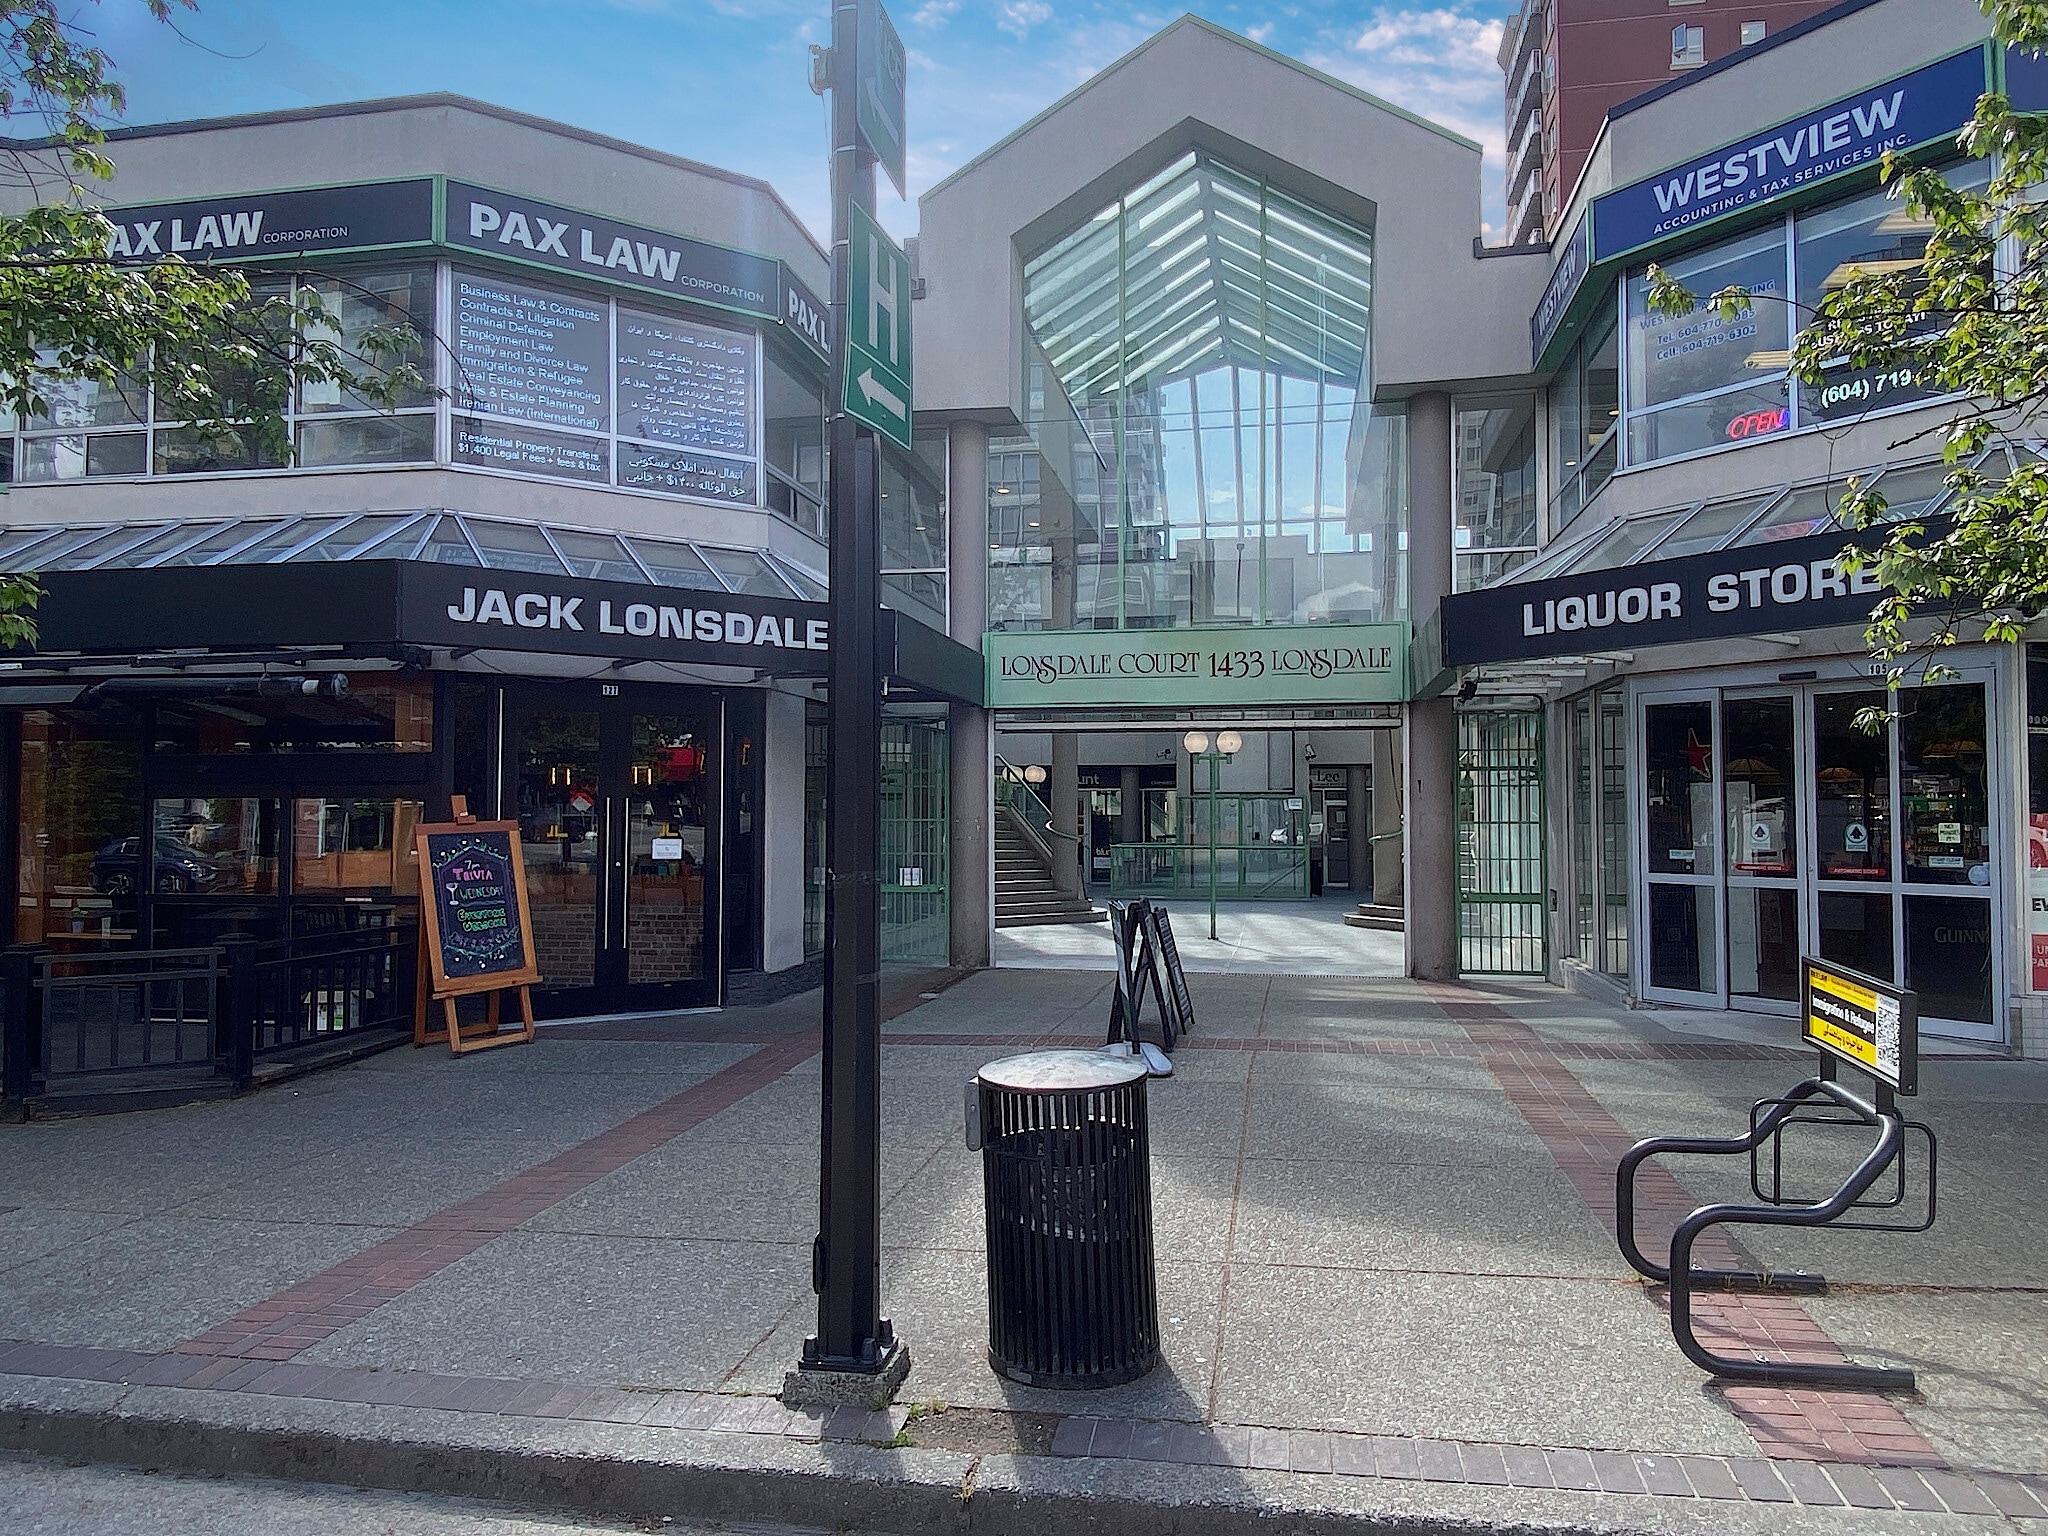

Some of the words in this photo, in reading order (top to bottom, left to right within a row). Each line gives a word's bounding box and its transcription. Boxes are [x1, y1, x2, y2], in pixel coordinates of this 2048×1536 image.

[1653, 89, 1904, 214] WESTVIEW
[1653, 192, 1745, 235] ACCOUNTING
[1748, 187, 1758, 200] &
[1760, 177, 1790, 195] TAX
[1794, 145, 1873, 183] SERVICES
[1877, 131, 1912, 153] INC.
[104, 219, 162, 258] AX
[171, 210, 264, 252] LAW
[263, 225, 348, 244] CORPORATION
[469, 202, 570, 259] PAX
[580, 228, 682, 283] LAW
[681, 275, 765, 304] CORPORATION
[459, 297, 513, 318] Contracts
[515, 309, 525, 320] &
[527, 311, 575, 330] Litigation
[460, 283, 511, 303] Business
[514, 294, 536, 308] Law
[538, 300, 547, 311] &
[550, 303, 600, 322] Contracts
[868, 231, 898, 366] H
[459, 312, 506, 329] Criminal
[508, 321, 554, 339] Defence
[788, 287, 818, 343] PAX
[459, 325, 529, 348] Employment
[532, 339, 554, 353] Law
[1656, 347, 1680, 361] Cell:
[1682, 324, 1757, 354] 604-719-6302
[459, 340, 496, 357] Family
[499, 348, 521, 360] and
[523, 352, 564, 368] Divorce
[567, 360, 589, 373] Law
[459, 354, 525, 375] Immigration
[527, 366, 536, 377] &
[538, 368, 584, 386] Refugee
[459, 368, 486, 381] Real
[488, 373, 523, 388] Estate
[526, 380, 601, 404] Conveyancing
[488, 387, 498, 398] &
[500, 389, 535, 404] Estate
[538, 395, 585, 414] Planning
[1821, 379, 1870, 409] (604)
[500, 402, 524, 416] Law
[1729, 411, 1785, 439] OPEN
[458, 443, 492, 457] $1,400
[493, 447, 520, 461] Legal
[522, 452, 546, 464] Fees
[556, 457, 576, 468] fees
[578, 459, 586, 470] &
[459, 431, 513, 448] Residential
[515, 440, 556, 456] Property
[557, 446, 600, 461] Transfers
[628, 455, 670, 469] مسکونی
[671, 460, 698, 473] املاک
[699, 465, 717, 476] سند
[718, 468, 744, 480] انتقال
[728, 485, 746, 497] حق
[1522, 581, 1682, 638] LIQUOR
[1707, 556, 1881, 613] STORE
[447, 586, 584, 632] JACK
[598, 600, 829, 651] LONSDALE
[1001, 653, 1111, 684] LONSDALE
[1118, 652, 1199, 674] COURT
[1209, 650, 1265, 678] 1433
[1271, 646, 1392, 679] LONSDALE
[1870, 664, 1887, 675] 105
[1317, 769, 1340, 782] Lee
